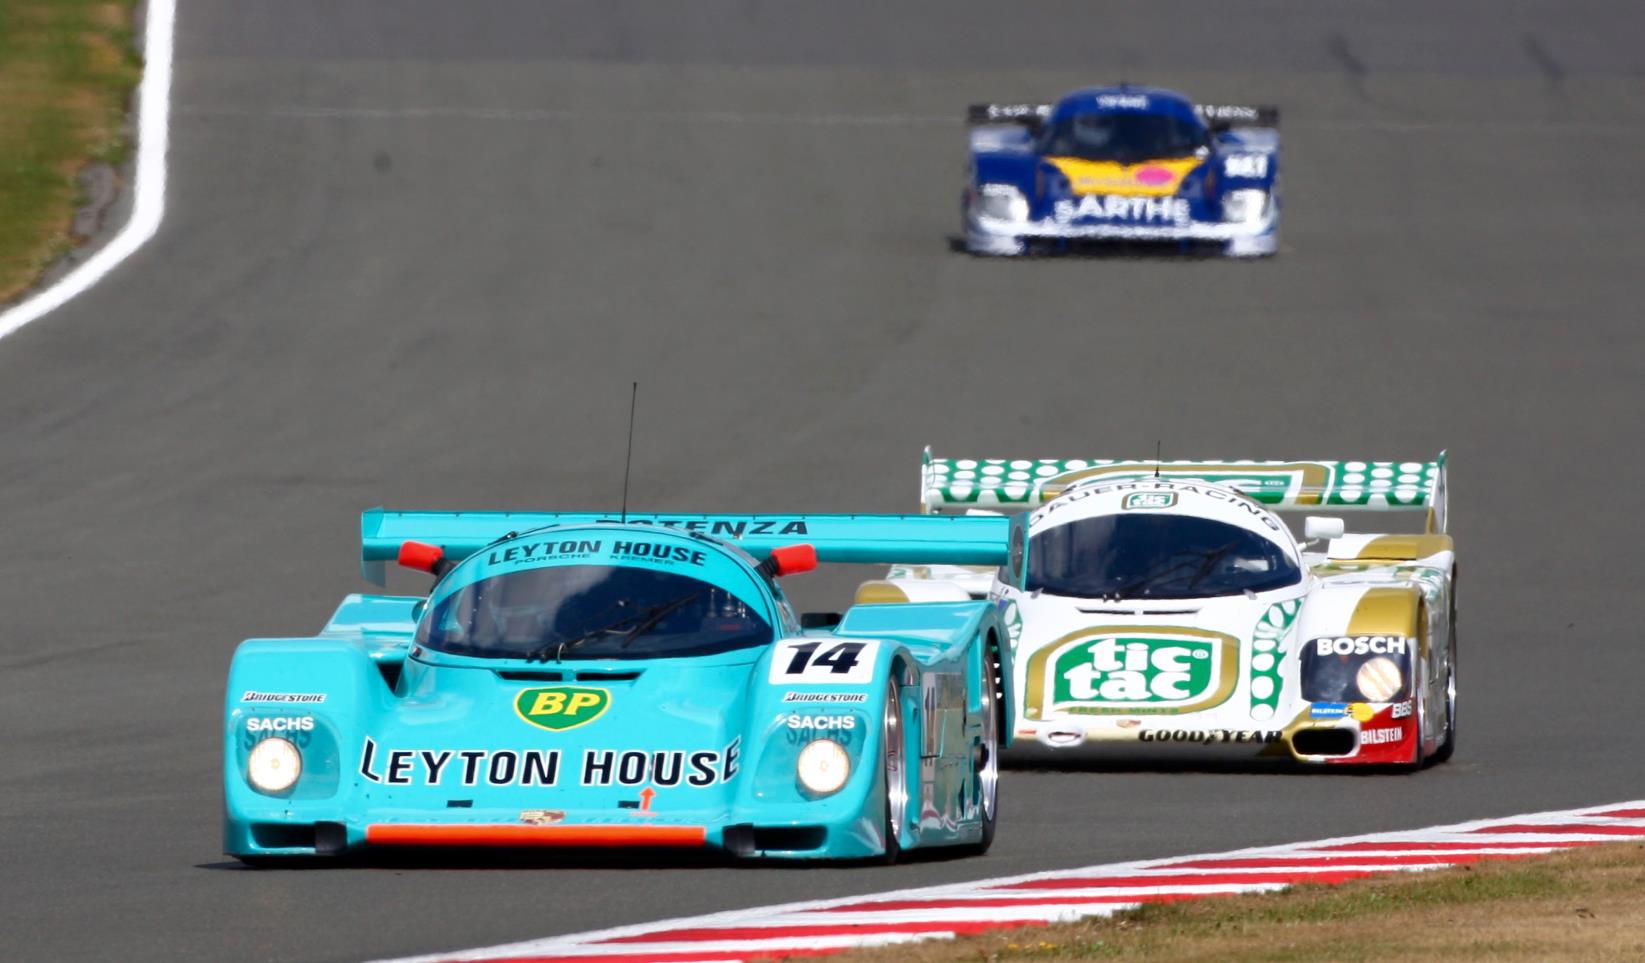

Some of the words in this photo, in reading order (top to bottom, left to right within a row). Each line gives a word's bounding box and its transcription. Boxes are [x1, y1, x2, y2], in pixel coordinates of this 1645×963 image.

[1054, 193, 1191, 225] SARTHE
[595, 519, 808, 535] TENZA
[488, 540, 602, 566] LEYTON
[612, 540, 707, 566] HOUSE
[514, 553, 592, 565] PORSCHE
[609, 555, 674, 566] KREMER
[1317, 636, 1405, 656] BOSCH
[785, 641, 868, 675] 14
[1063, 662, 1191, 700] tac
[244, 691, 324, 702] BRIDGESTONE
[528, 692, 601, 716] BP
[784, 692, 866, 702] BRIDGESTONE
[1391, 699, 1412, 719] BBS
[246, 716, 314, 731] SACHS
[787, 715, 855, 729] SACHS
[1360, 726, 1402, 745] BILSTEIN
[359, 736, 561, 786] LEYTON
[580, 735, 741, 786] HOUSE
